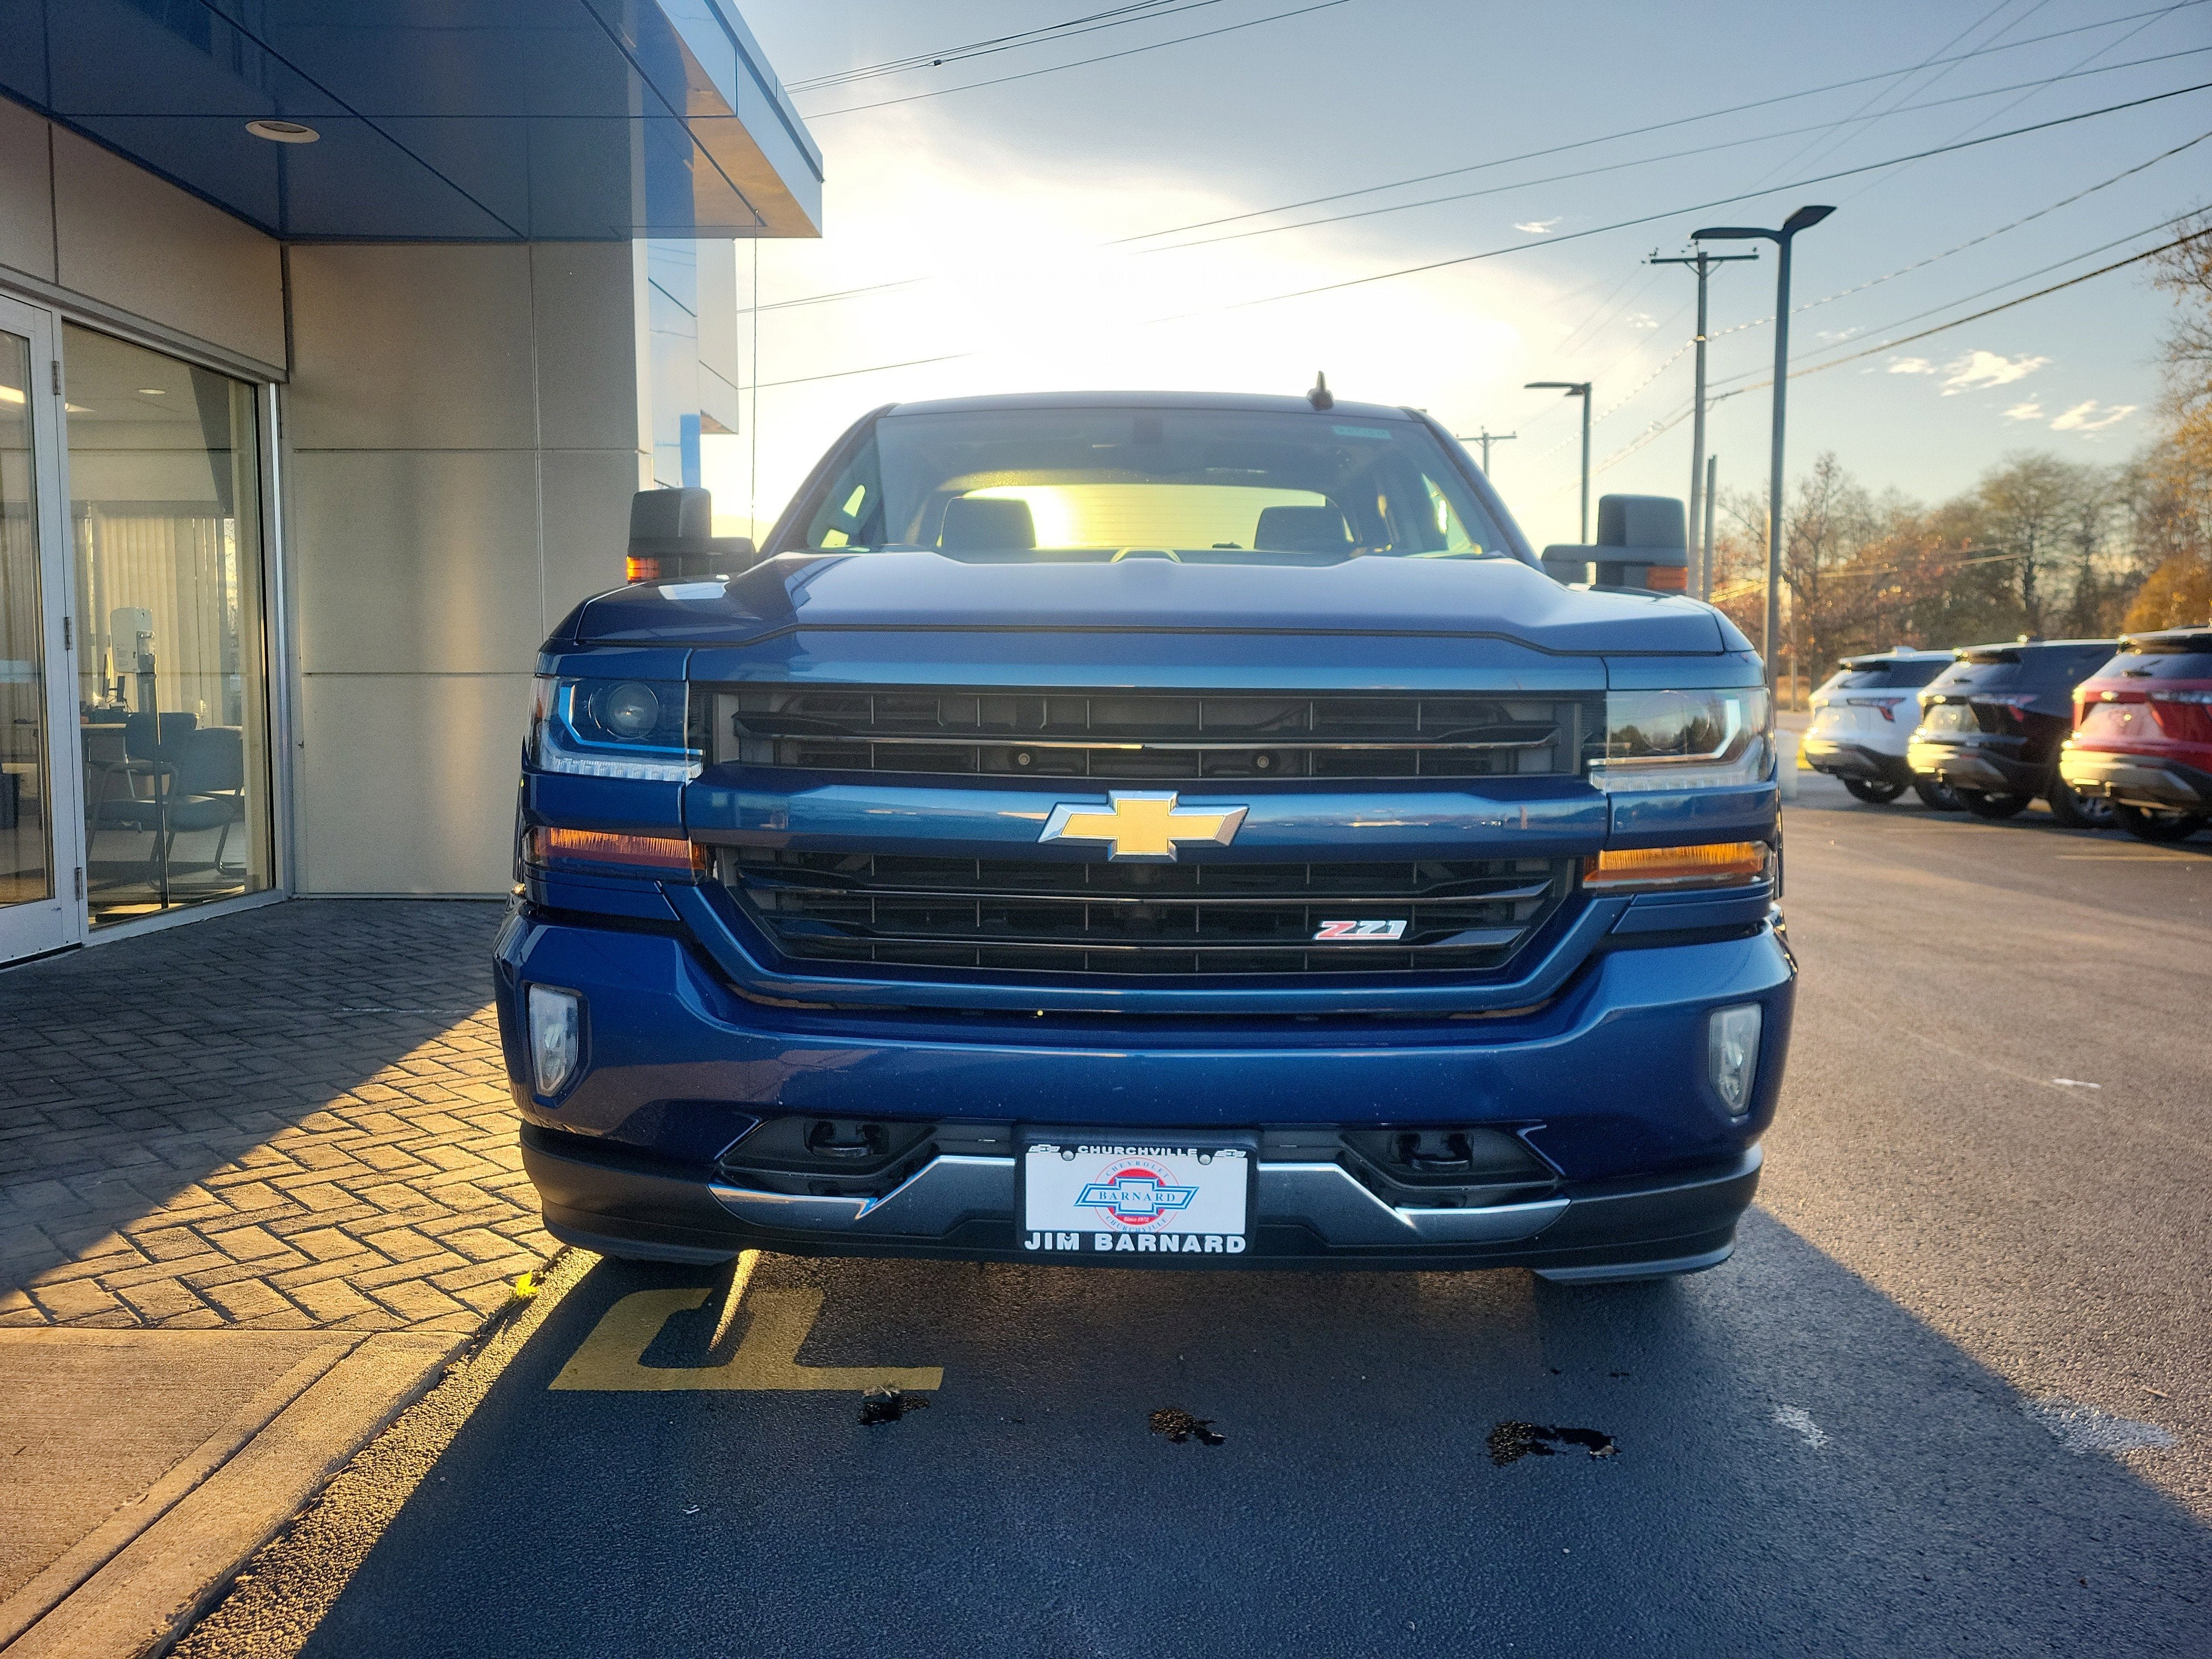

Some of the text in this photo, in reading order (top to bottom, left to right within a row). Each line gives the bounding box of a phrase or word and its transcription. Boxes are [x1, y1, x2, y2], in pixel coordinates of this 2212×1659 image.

[1316, 920, 1407, 940] Z71
[1078, 1145, 1197, 1156] CHURCHVILLE
[1106, 1161, 1168, 1178] CHEVROLET
[1099, 1191, 1175, 1201] BARNARD
[1024, 1232, 1246, 1253] JIM BARNARD
